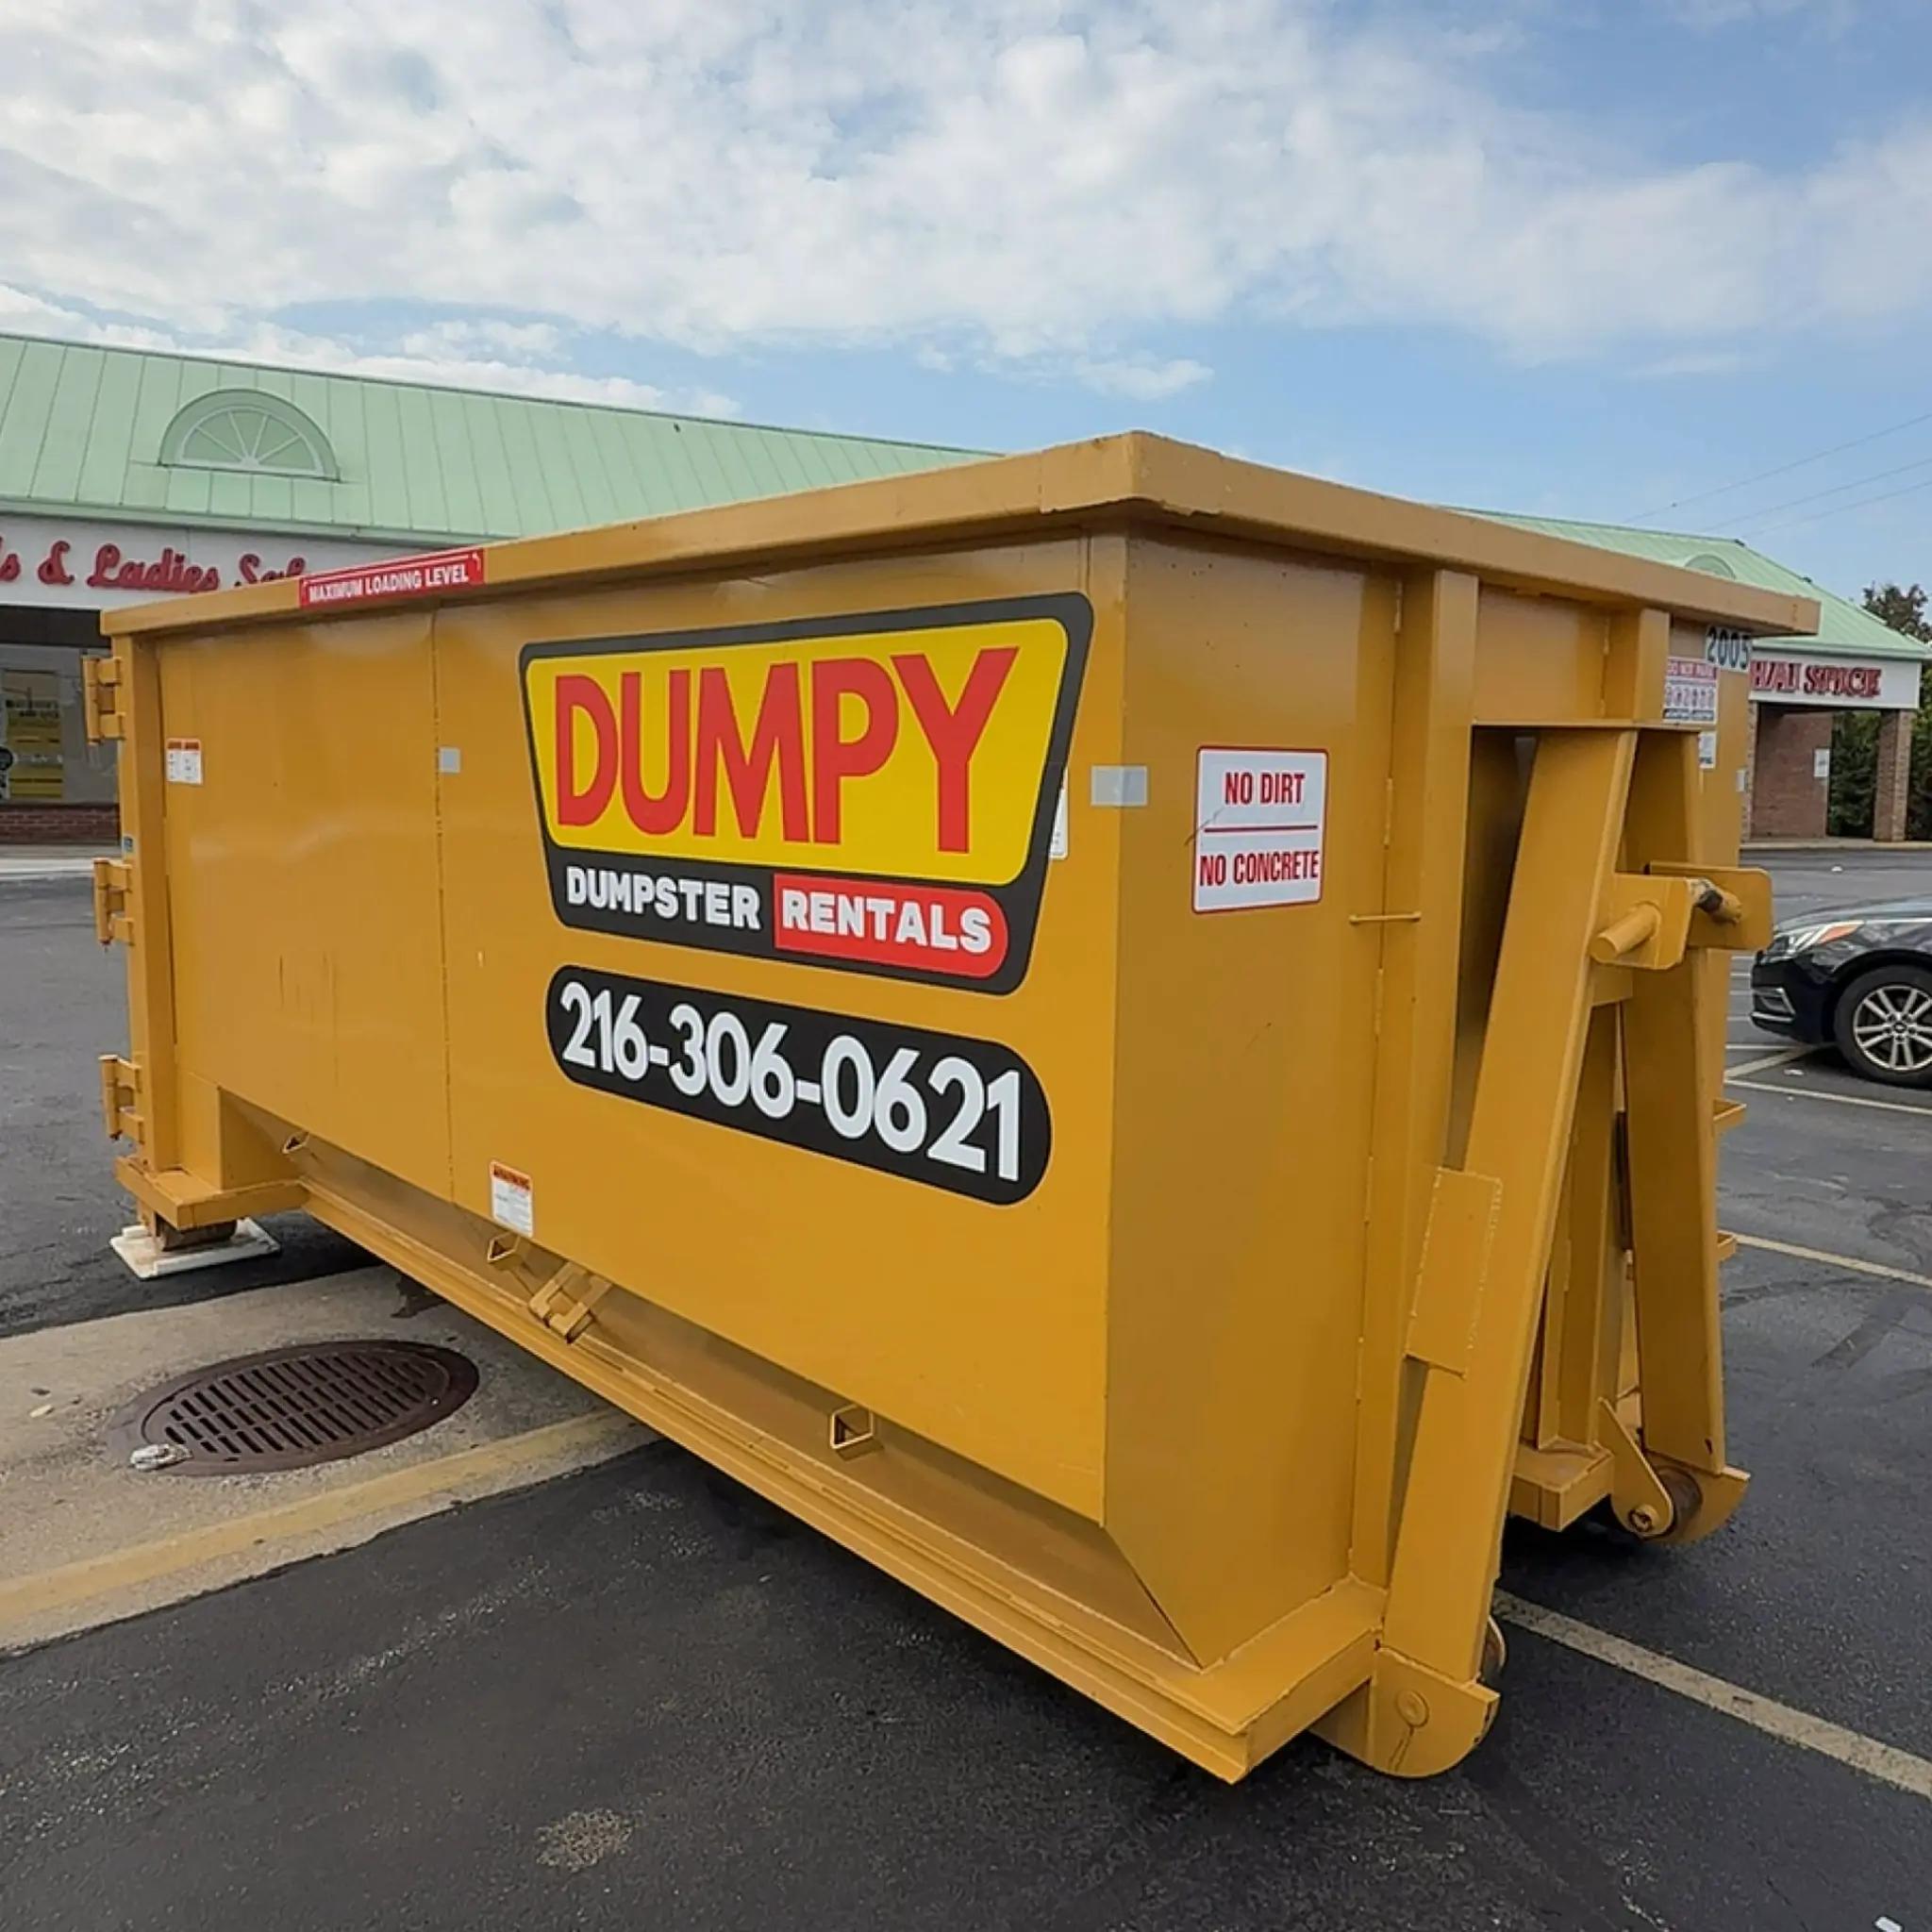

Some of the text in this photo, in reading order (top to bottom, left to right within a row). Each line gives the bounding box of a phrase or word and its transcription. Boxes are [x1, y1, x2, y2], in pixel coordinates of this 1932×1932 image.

[38, 541, 75, 584] &
[87, 544, 220, 592] Ladies
[309, 563, 470, 603] MAXIMUM LOADING LEVEL
[1706, 625, 1749, 670] 2005
[555, 646, 1019, 854] DUMPY
[1224, 772, 1306, 805] NO DIRT
[1199, 851, 1320, 886] NO CONCRETE
[567, 867, 991, 954] DUMPSTER RENTALS
[560, 981, 1020, 1181] 216-306-0621
